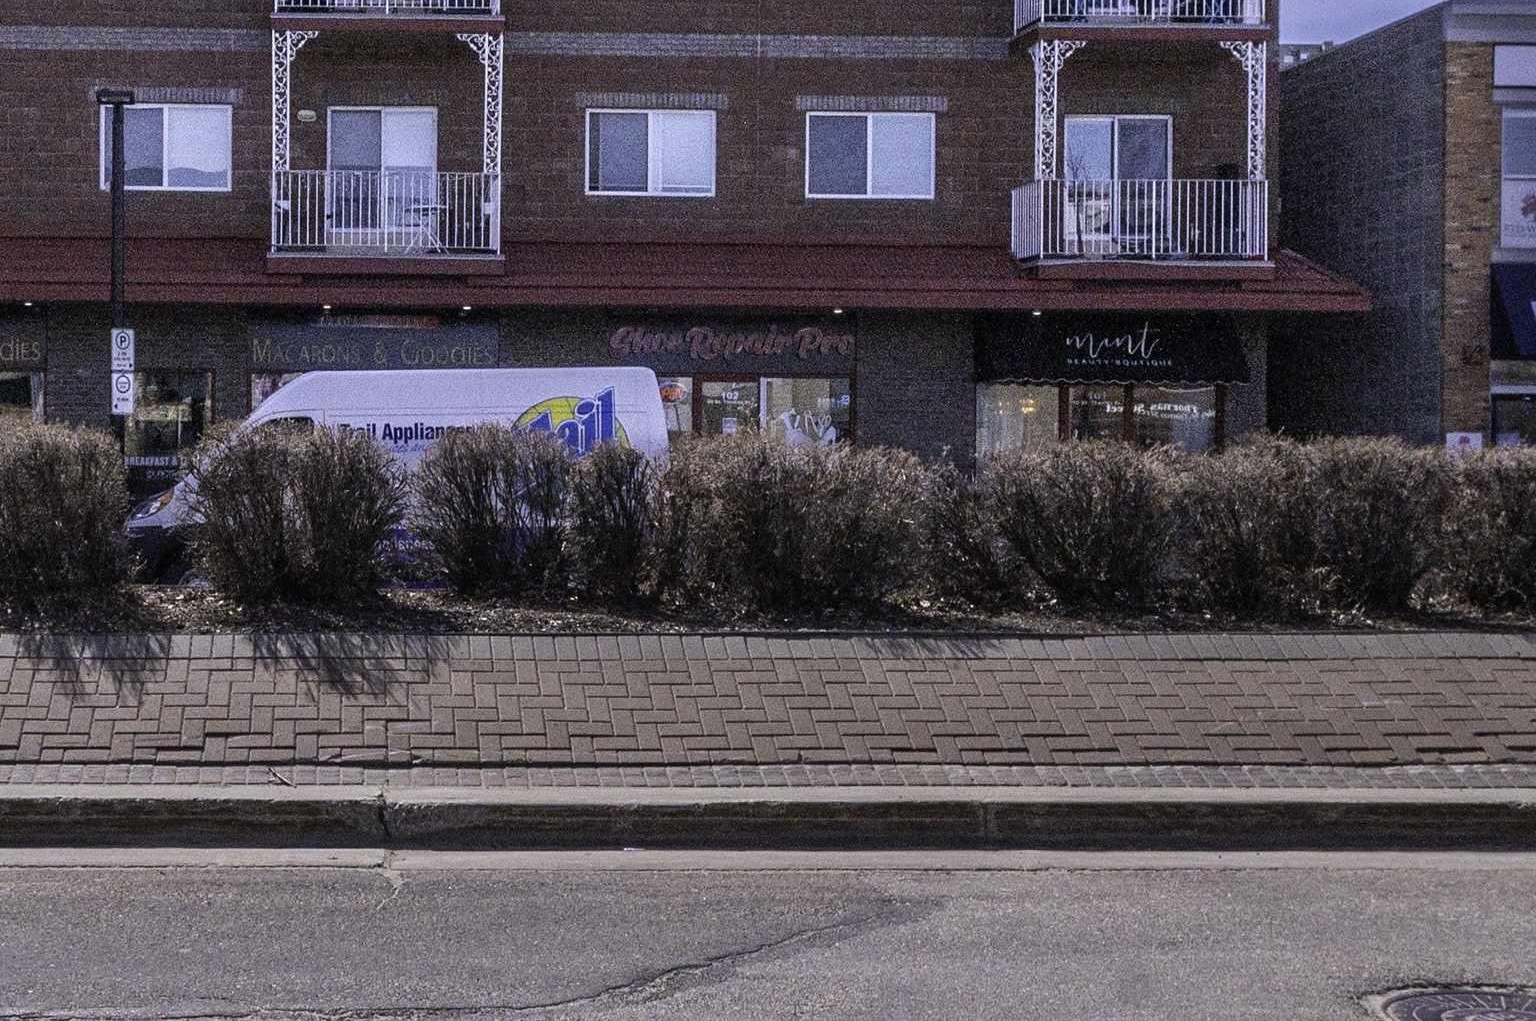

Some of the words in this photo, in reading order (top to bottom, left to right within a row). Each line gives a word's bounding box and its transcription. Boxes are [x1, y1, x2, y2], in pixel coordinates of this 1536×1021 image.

[119, 335, 127, 347] P
[371, 340, 386, 364] &
[1066, 358, 1110, 366] BEAUTY
[1114, 359, 1173, 367] BOUTIQUE
[720, 391, 739, 401] 102
